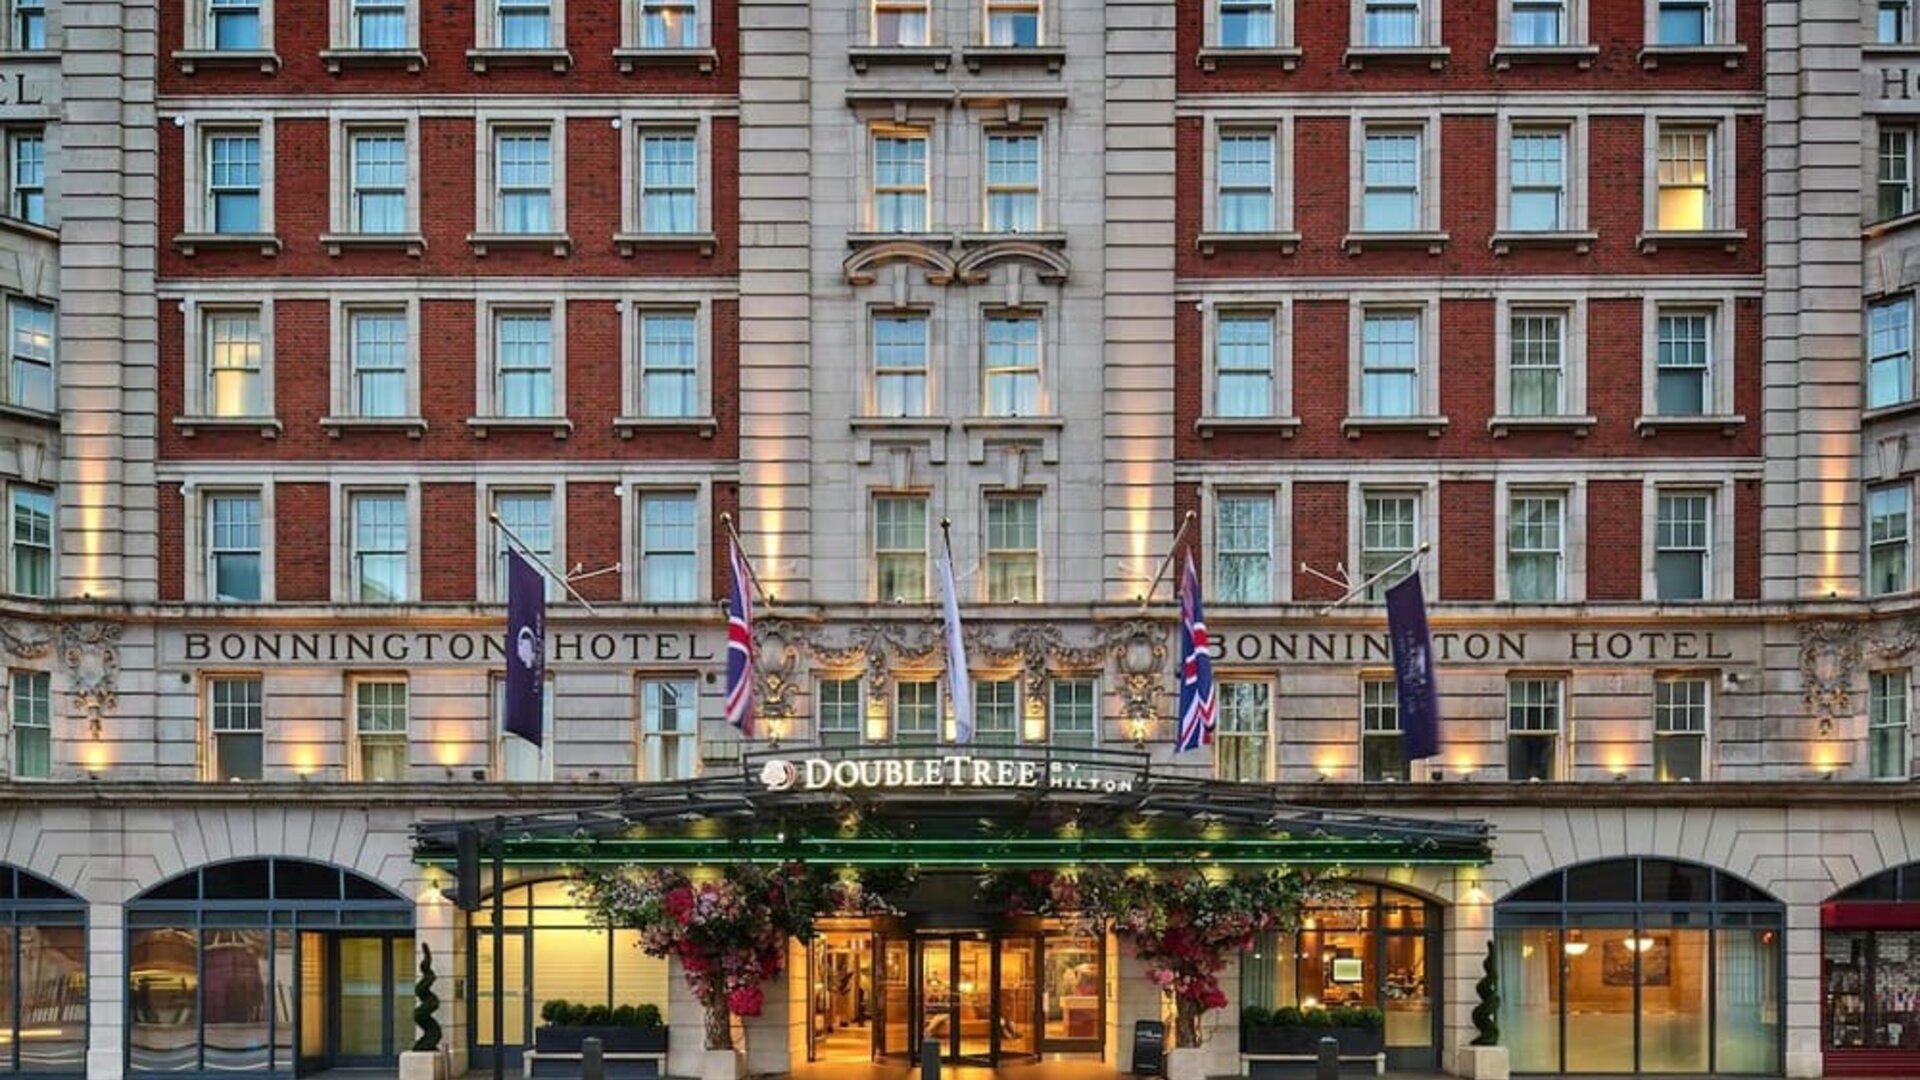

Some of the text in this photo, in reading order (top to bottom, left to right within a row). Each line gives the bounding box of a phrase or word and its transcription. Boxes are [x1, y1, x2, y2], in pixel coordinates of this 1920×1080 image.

[0, 74, 43, 105] L
[1881, 68, 1920, 99] H
[185, 633, 714, 660] BONNINGTON HOTEL
[1206, 632, 1733, 660] BONNINTON HOTEL
[1050, 761, 1079, 773] BY
[1050, 776, 1132, 793] HILTON
